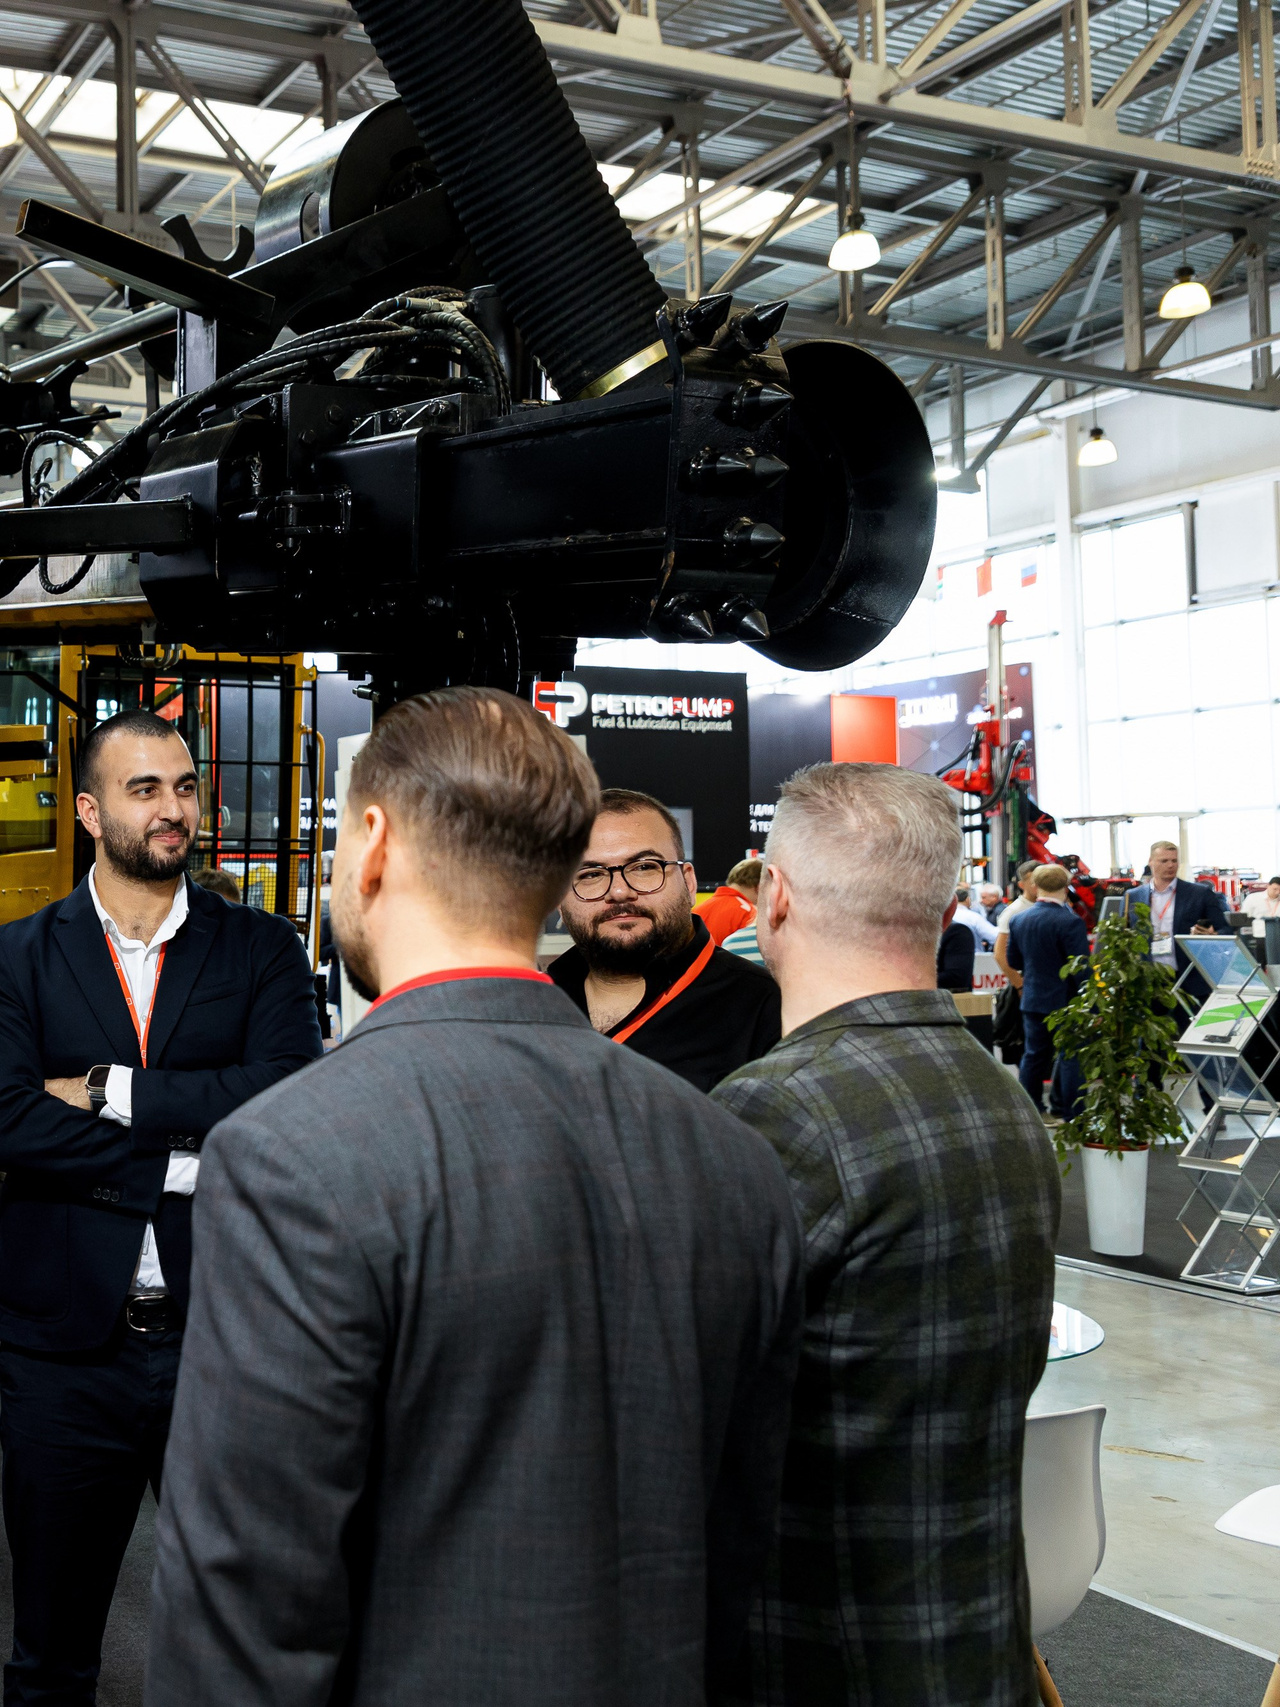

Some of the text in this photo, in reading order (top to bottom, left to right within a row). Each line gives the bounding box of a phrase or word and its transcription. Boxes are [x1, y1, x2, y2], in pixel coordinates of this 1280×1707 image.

[591, 693, 735, 718] PETROPUMP
[592, 716, 733, 733] Fuel & Lubrication Equipment
